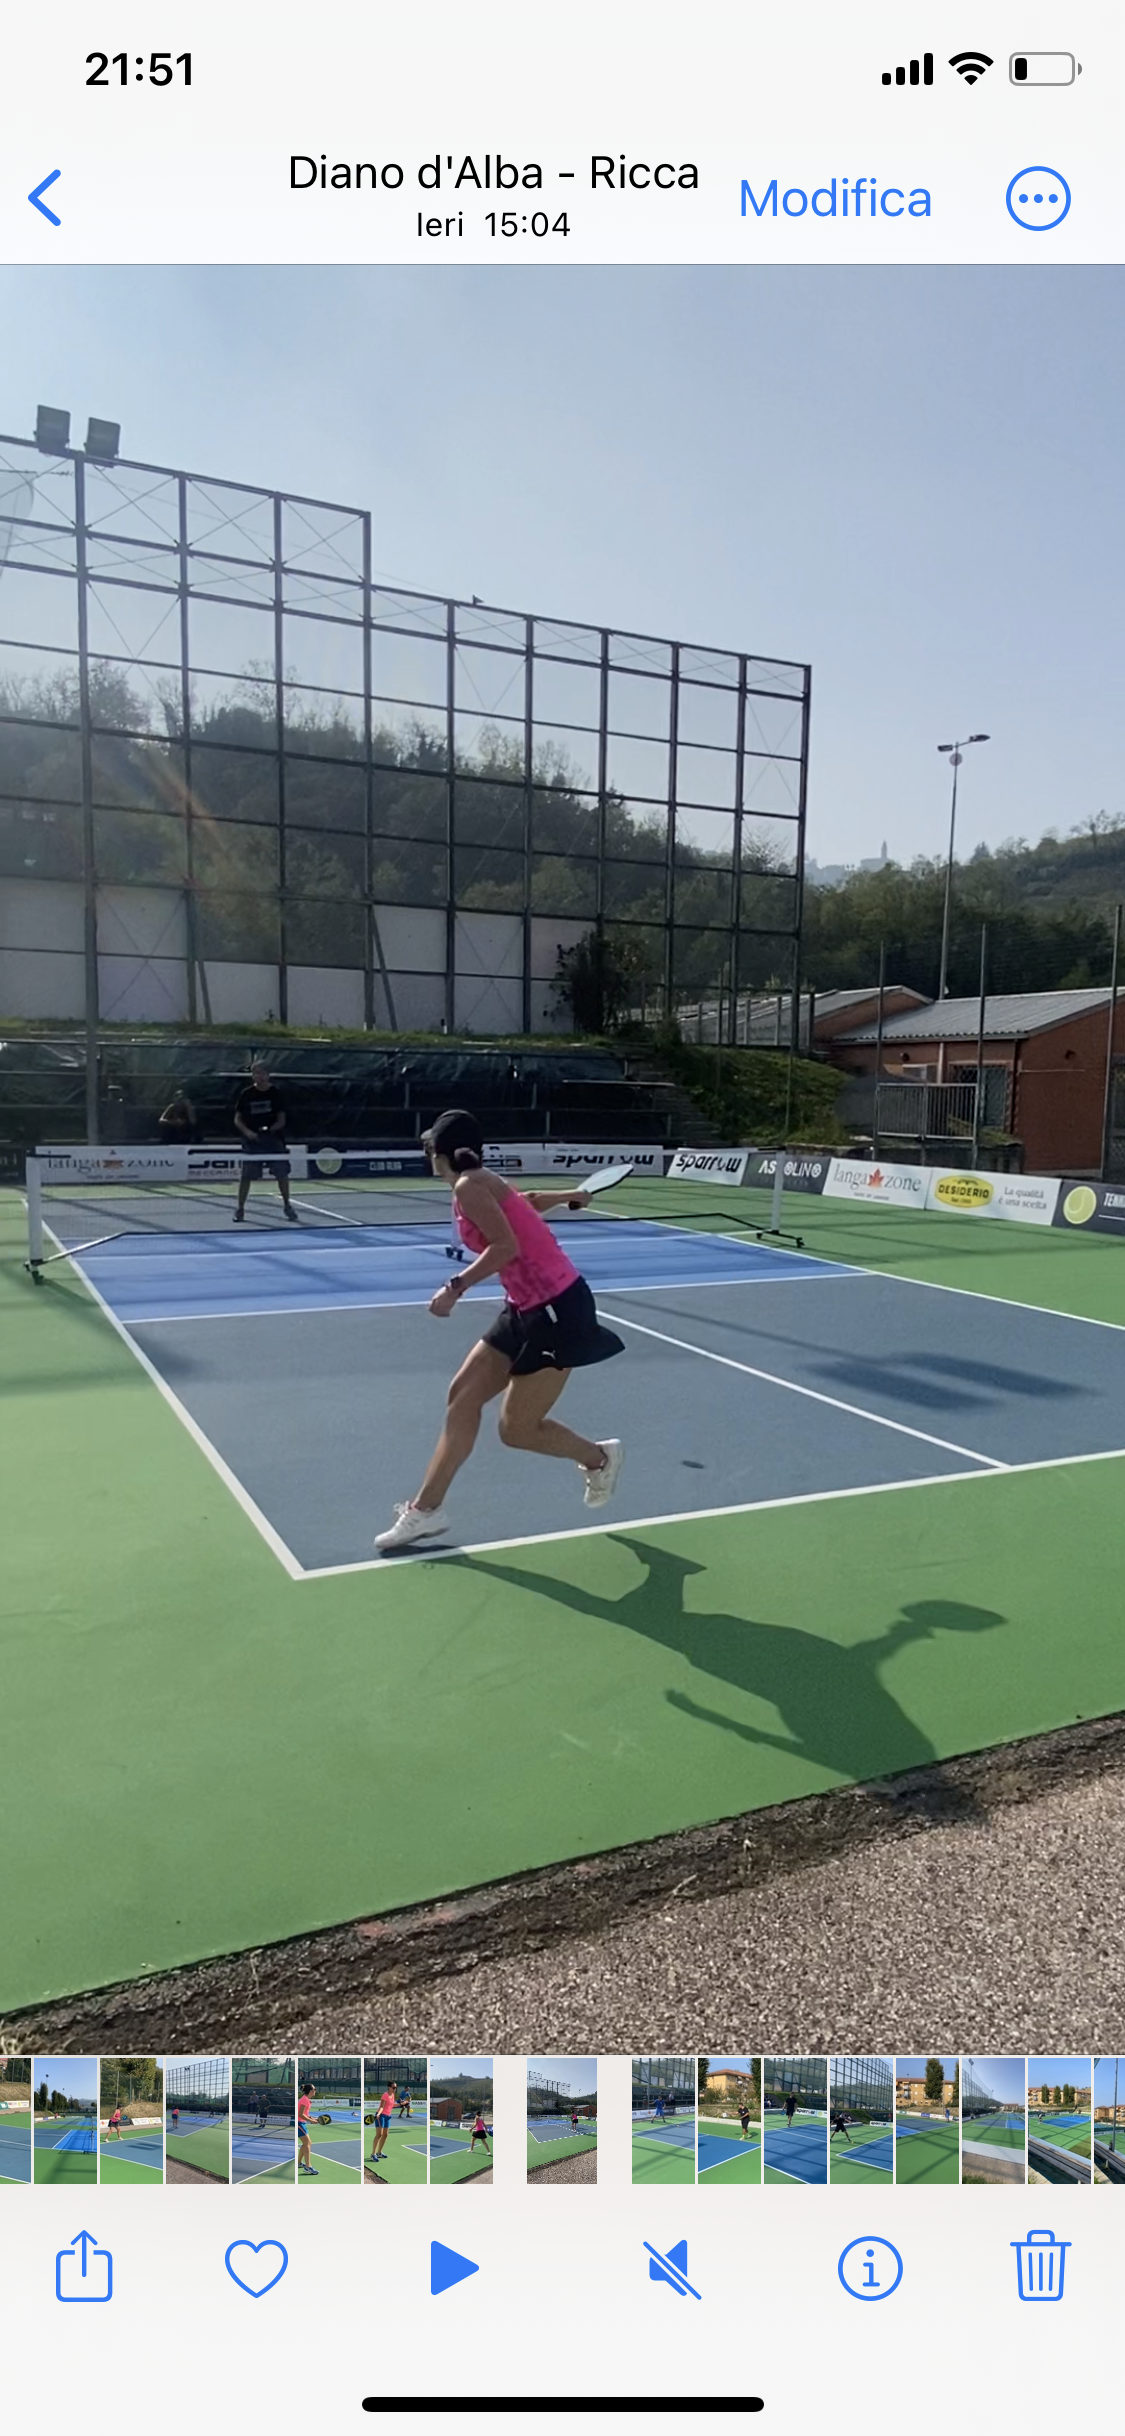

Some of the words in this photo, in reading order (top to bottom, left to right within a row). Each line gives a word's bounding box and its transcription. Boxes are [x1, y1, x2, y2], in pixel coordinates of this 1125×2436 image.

[675, 1153, 742, 1173] sparrow
[758, 1159, 822, 1178] ASOLINO
[833, 1163, 868, 1190] langa
[884, 1175, 922, 1192] zone
[938, 1184, 990, 1199] DESIDERIO
